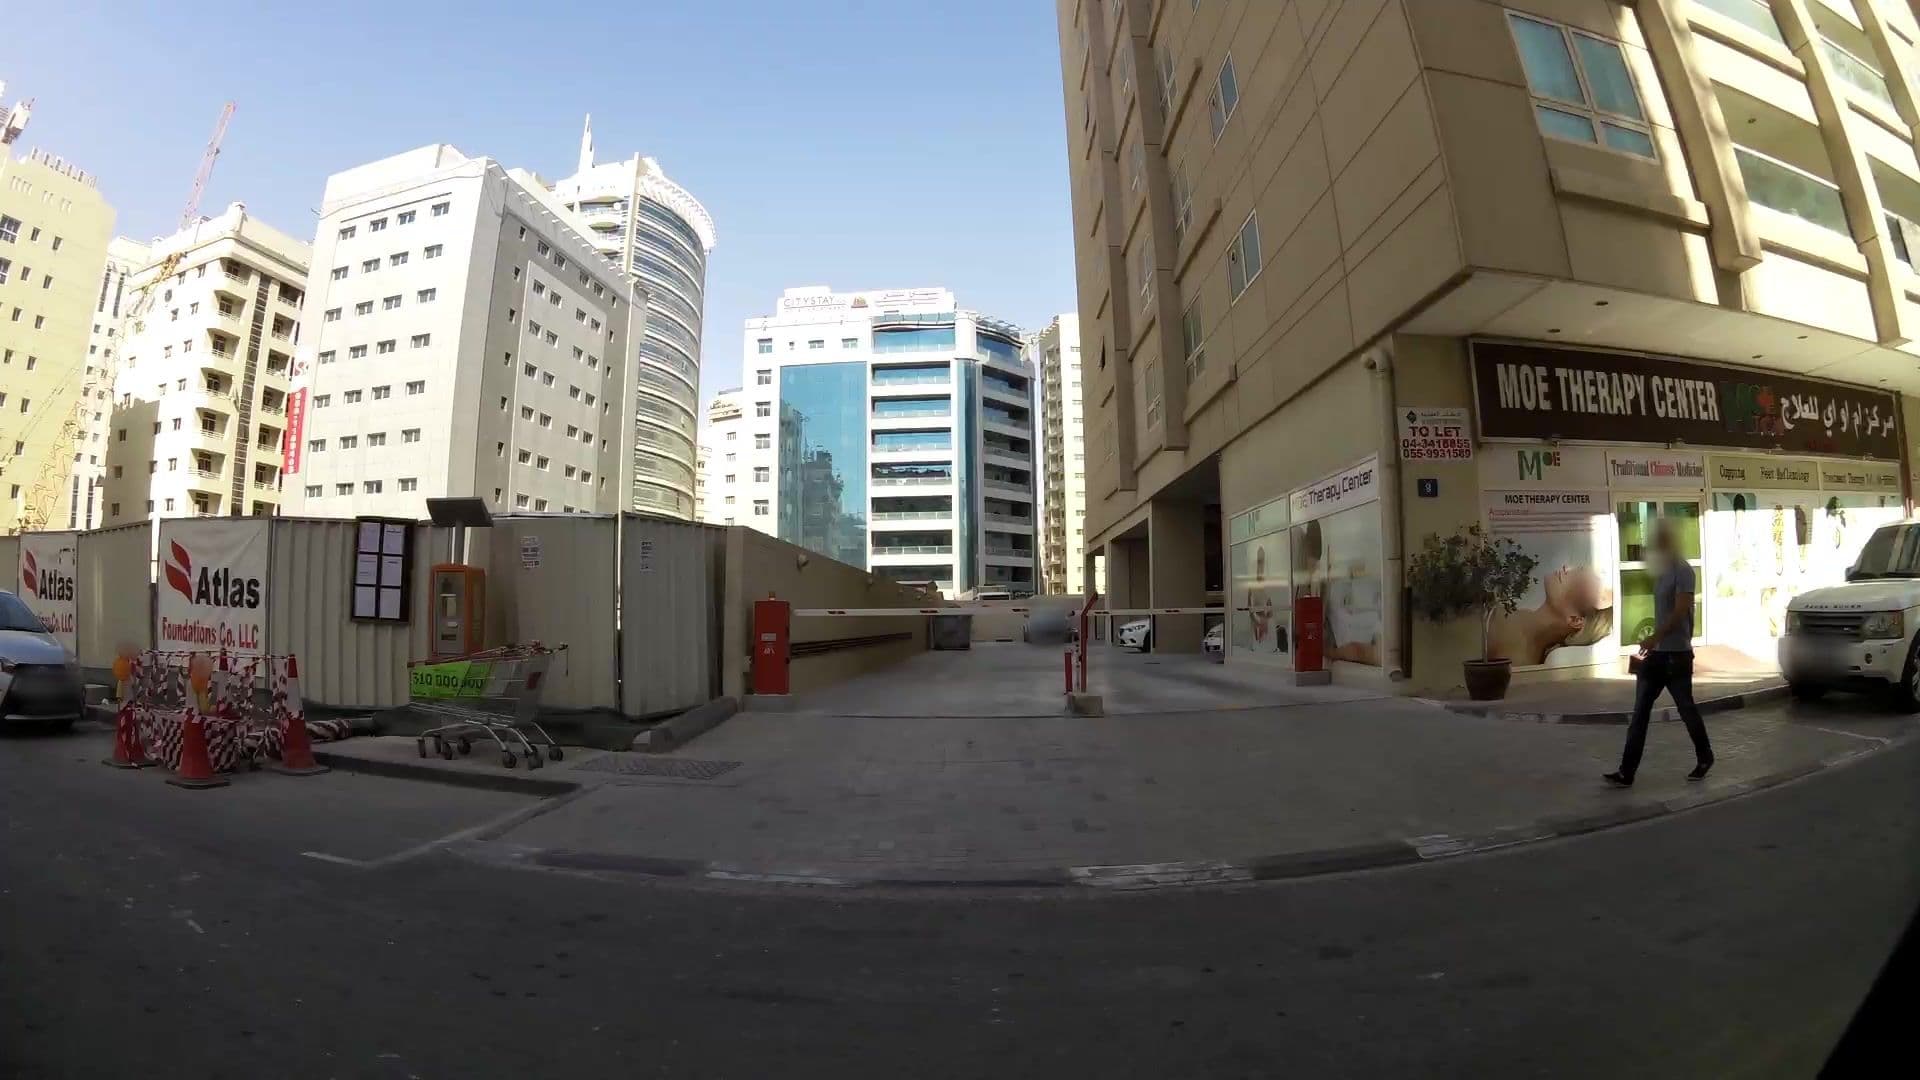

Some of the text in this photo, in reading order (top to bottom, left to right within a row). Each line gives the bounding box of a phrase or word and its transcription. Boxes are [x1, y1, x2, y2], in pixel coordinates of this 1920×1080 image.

[1496, 363, 1552, 411] MOE
[1555, 367, 1647, 416] THERAPY
[1651, 375, 1720, 422] CENTER
[1780, 393, 1820, 430] للعلاج
[1408, 426, 1462, 438] TO LET
[1308, 483, 1341, 505] Therapy
[1342, 468, 1373, 493] Center
[1504, 494, 1591, 505] MOE THERAPY CENTER
[38, 568, 74, 602] Atlas
[194, 566, 261, 609] Atlas
[162, 616, 260, 650] Foundations Co. LLC
